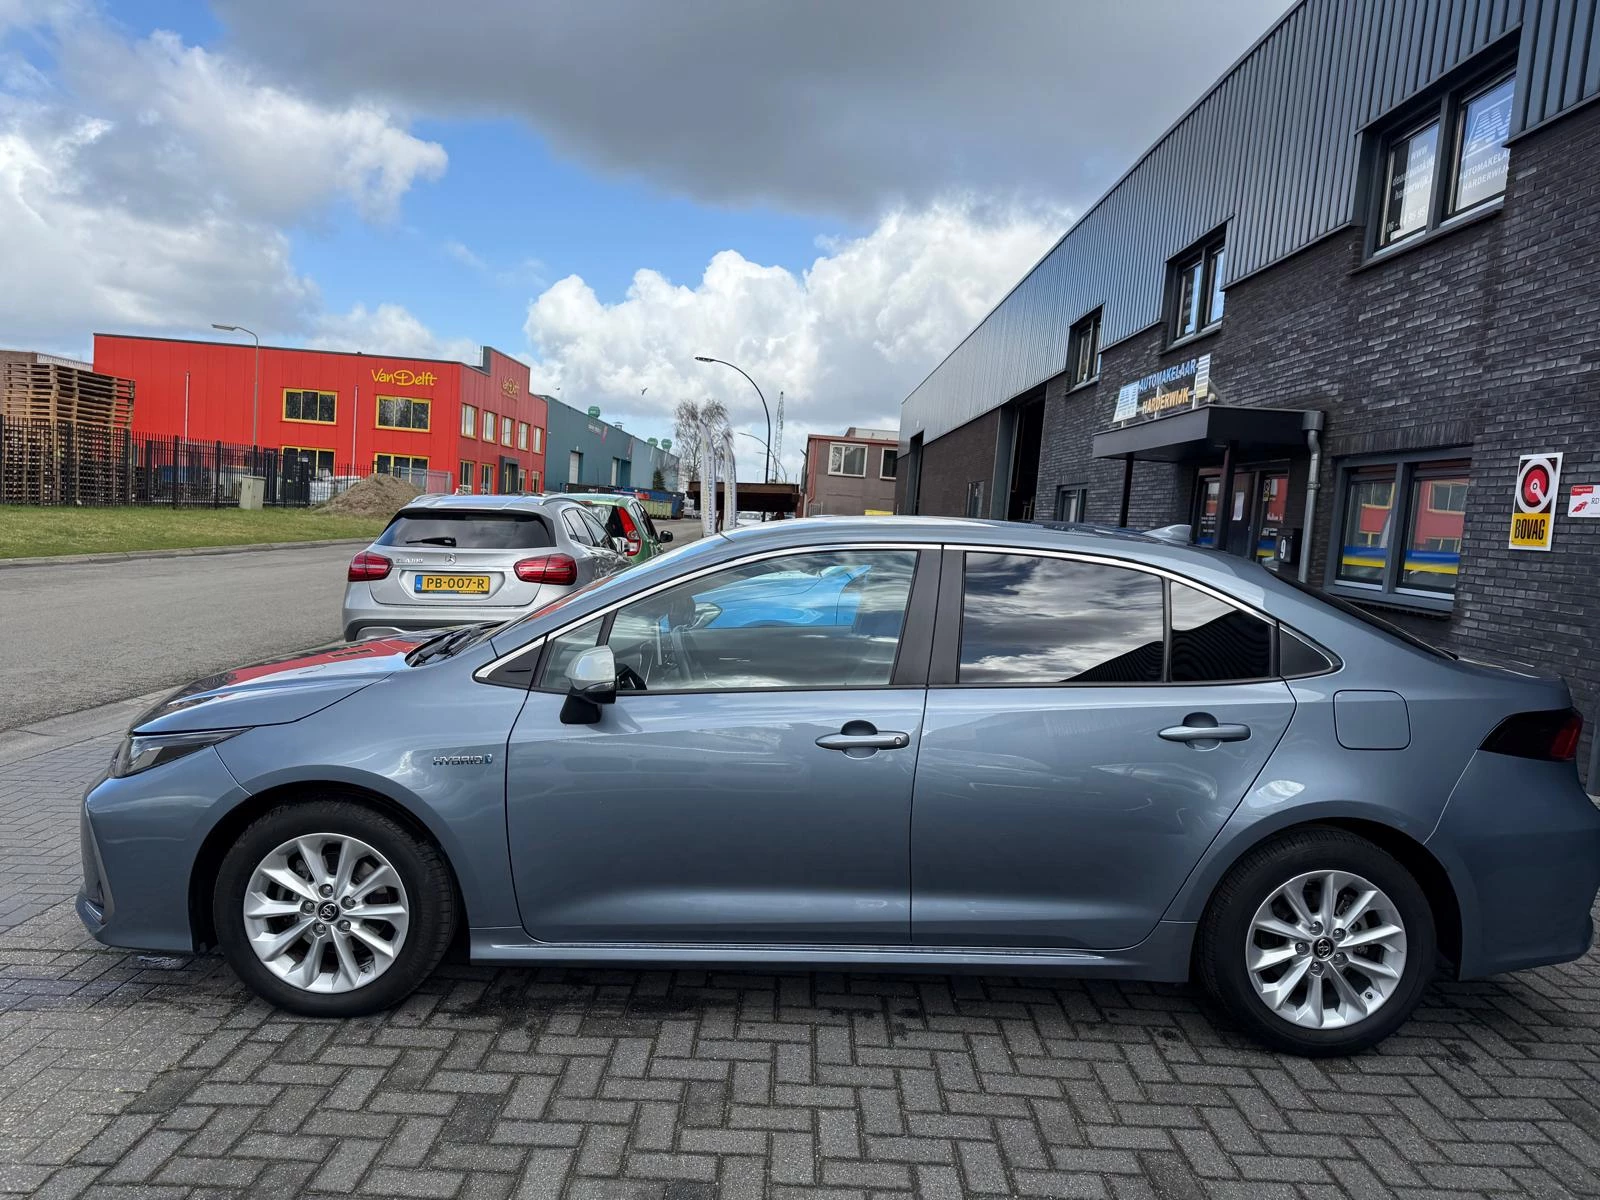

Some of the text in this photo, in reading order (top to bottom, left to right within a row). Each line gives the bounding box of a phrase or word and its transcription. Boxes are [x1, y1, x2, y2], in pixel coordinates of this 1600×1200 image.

[1139, 359, 1196, 392] AUTOMAKELAAR
[1142, 386, 1189, 414] HARDERWIJK
[1514, 518, 1545, 540] BOVAG
[1280, 539, 1286, 559] 9
[426, 577, 485, 589] PB-007-R
[433, 756, 483, 766] HYBRID
